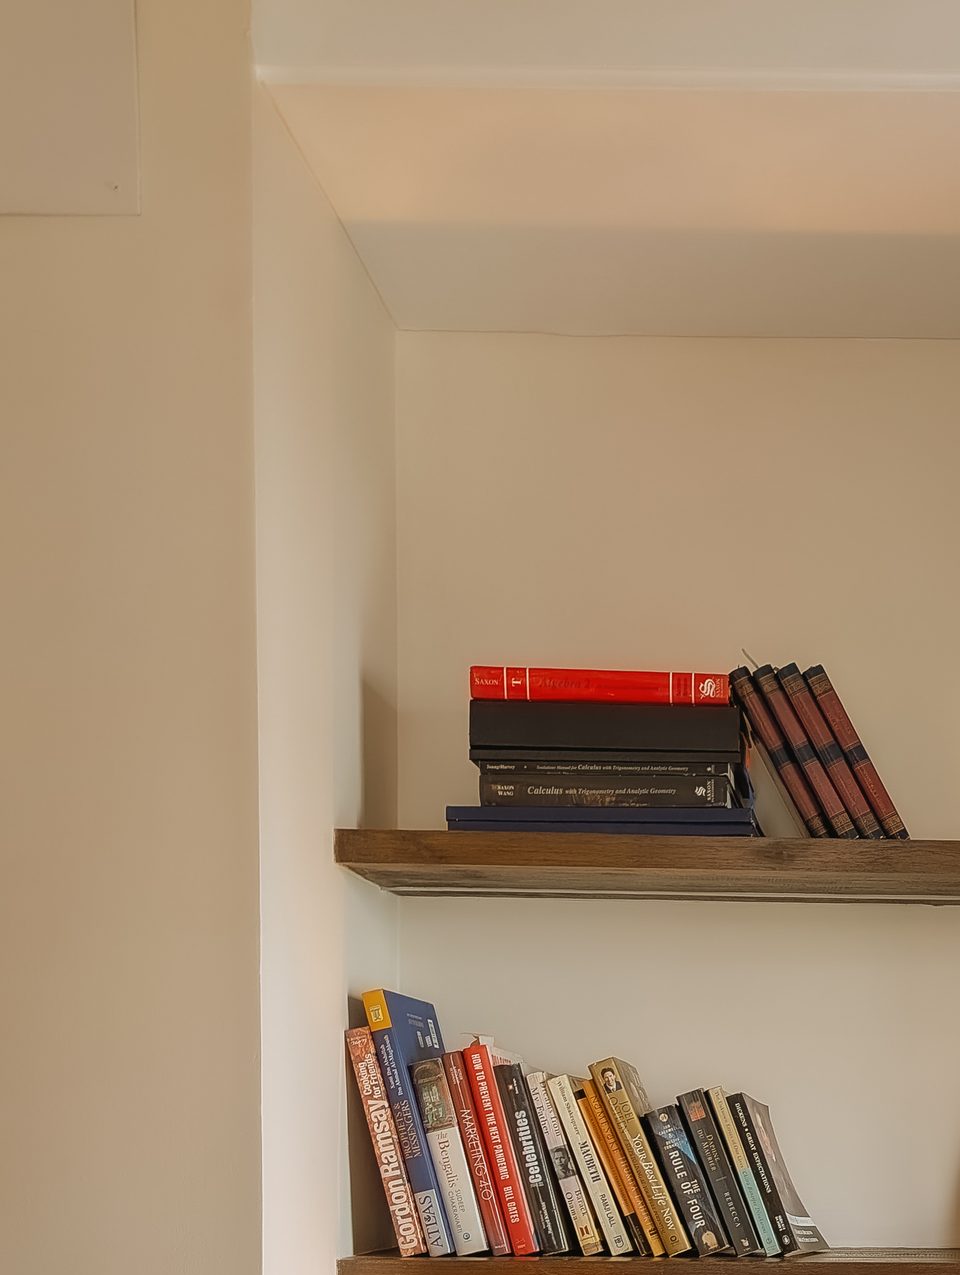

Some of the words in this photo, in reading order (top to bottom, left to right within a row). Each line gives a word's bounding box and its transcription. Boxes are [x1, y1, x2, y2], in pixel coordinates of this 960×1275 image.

[474, 678, 498, 686] SAXON
[527, 786, 563, 795] Calculus
[364, 1053, 377, 1084] Friends
[471, 1053, 482, 1069] HOW
[475, 1070, 485, 1080] TO
[357, 1062, 371, 1095] Cooking
[373, 1086, 381, 1098] for
[557, 1080, 567, 1102] William
[478, 1081, 492, 1110] PREVENT
[485, 1112, 496, 1125] THE
[530, 1087, 539, 1101] My
[536, 1105, 550, 1134] Father
[619, 1100, 633, 1122] JOEL
[735, 1102, 746, 1126] DICKENS
[364, 1100, 399, 1176] Ramsay
[395, 1111, 411, 1158] PROPHETS
[400, 1100, 421, 1156] MESSENGERS
[489, 1126, 500, 1142] NEXT
[550, 1115, 561, 1136] from
[461, 1109, 487, 1175] MARKETING
[515, 1111, 541, 1182] Celebrities
[701, 1141, 715, 1170] MAURIER
[438, 1140, 457, 1187] Bengalis
[494, 1144, 508, 1179] PANDEMIC
[578, 1141, 600, 1181] MACBETH
[631, 1133, 646, 1162] YOUR
[641, 1162, 657, 1182] Best
[651, 1185, 667, 1205] Life
[669, 1150, 687, 1179] RULE
[745, 1132, 756, 1150] GREAT
[753, 1152, 770, 1192] EXPECTATIONS
[454, 1189, 465, 1212] SUDEEP
[503, 1186, 514, 1200] BILL
[680, 1182, 695, 1195] OF
[691, 1179, 701, 1194] THE
[387, 1180, 416, 1248] Gordon
[447, 1191, 462, 1233] CHAKRAVARTI
[507, 1201, 519, 1222] GATES
[565, 1191, 577, 1220] Obama
[574, 1189, 587, 1216] Barack
[600, 1193, 610, 1210] RAMJI
[606, 1211, 616, 1227] LALL
[687, 1198, 706, 1228] FOUR
[724, 1191, 740, 1226] REBECCA
[418, 1195, 442, 1246] ATLAS
